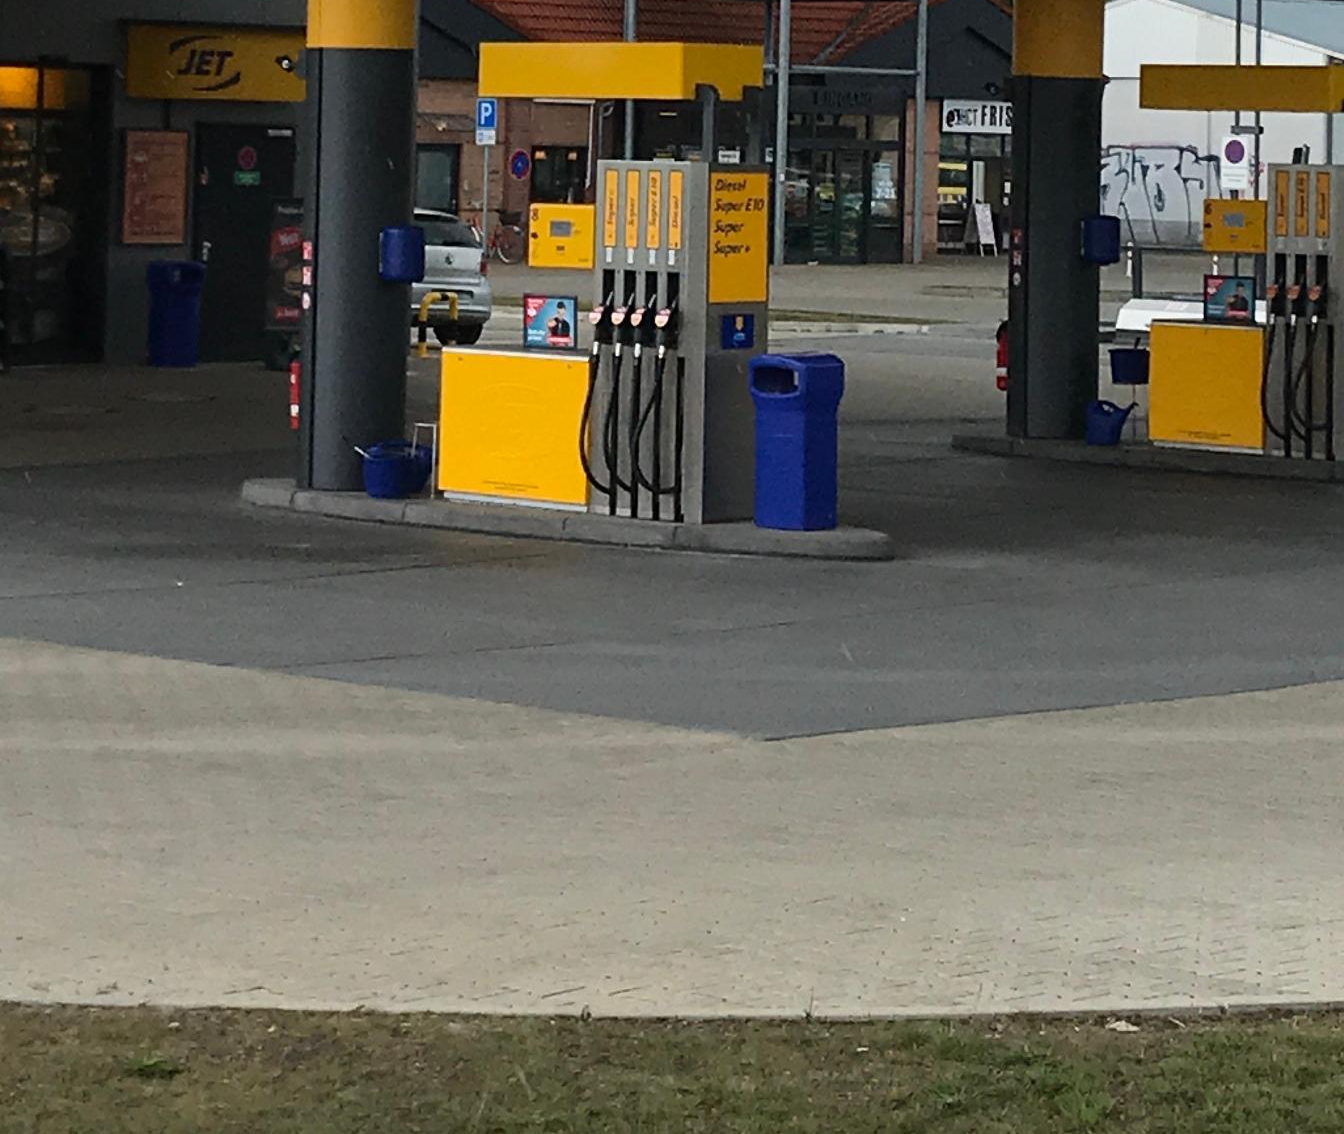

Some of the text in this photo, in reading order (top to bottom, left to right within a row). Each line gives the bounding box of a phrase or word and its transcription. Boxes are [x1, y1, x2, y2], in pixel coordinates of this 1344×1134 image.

[177, 49, 233, 76] JET
[480, 102, 493, 125] P
[715, 179, 747, 192] Diesel
[714, 197, 765, 215] Super E10
[714, 219, 744, 238] Super
